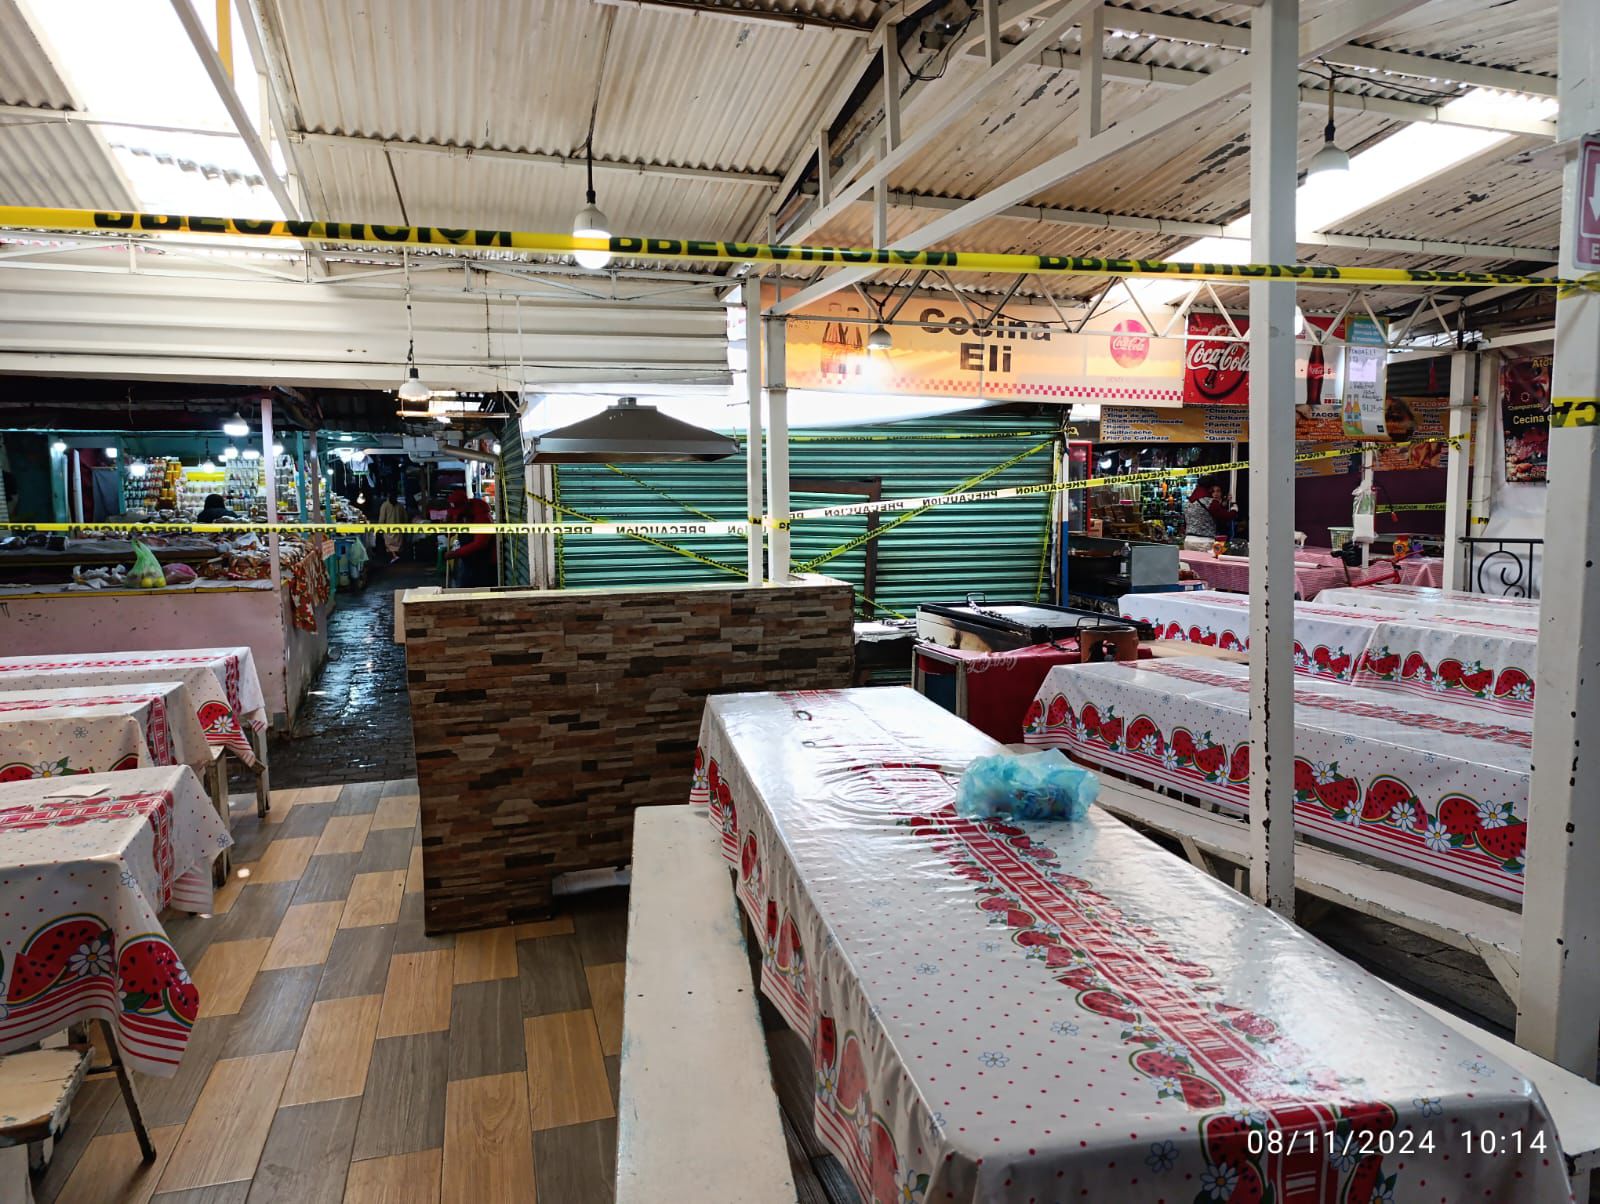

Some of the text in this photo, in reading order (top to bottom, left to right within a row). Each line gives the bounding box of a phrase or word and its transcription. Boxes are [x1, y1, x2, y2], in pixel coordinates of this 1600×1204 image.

[919, 307, 1051, 342] Cocina
[960, 342, 1012, 373] Eli
[1513, 414, 1544, 424] Cecina
